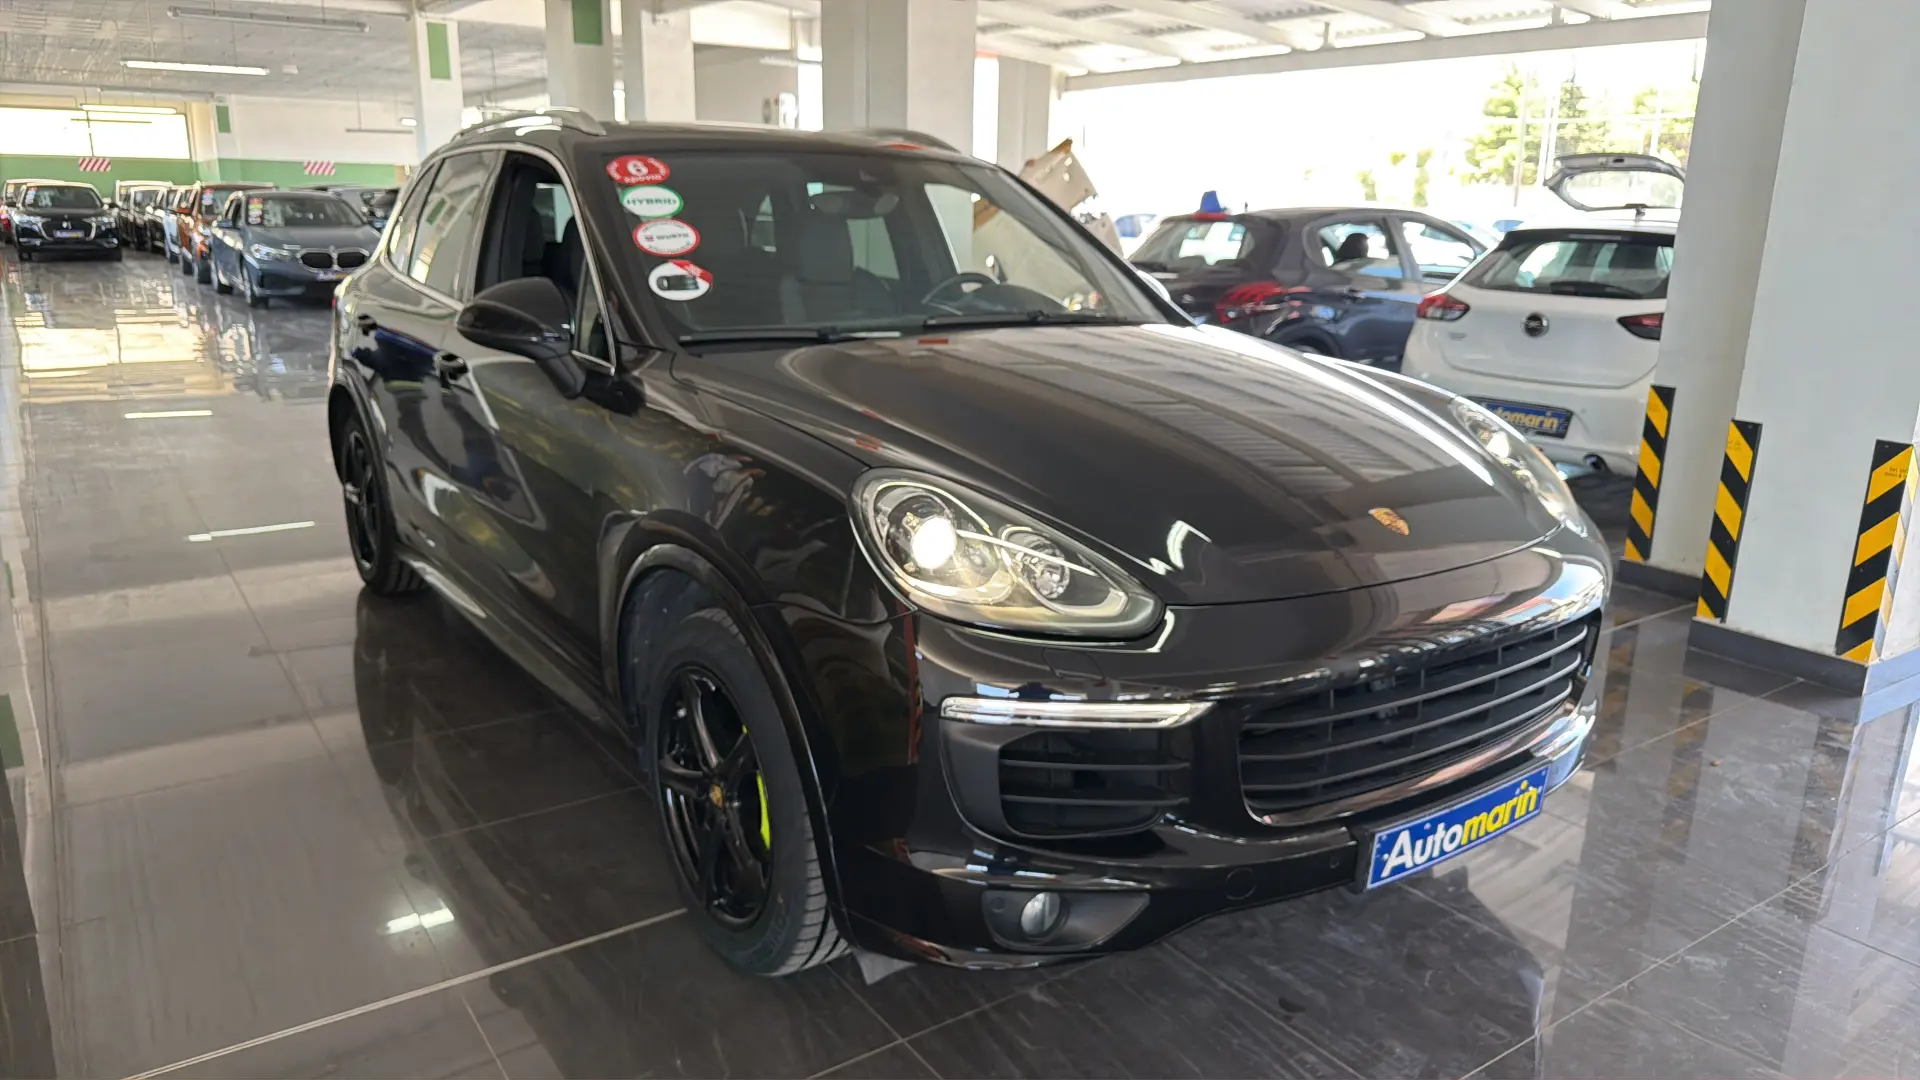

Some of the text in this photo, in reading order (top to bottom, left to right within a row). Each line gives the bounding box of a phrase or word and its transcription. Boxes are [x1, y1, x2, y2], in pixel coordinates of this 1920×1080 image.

[627, 160, 648, 175] 6
[626, 197, 677, 206] HYBRID
[1380, 779, 1539, 879] Automarin
